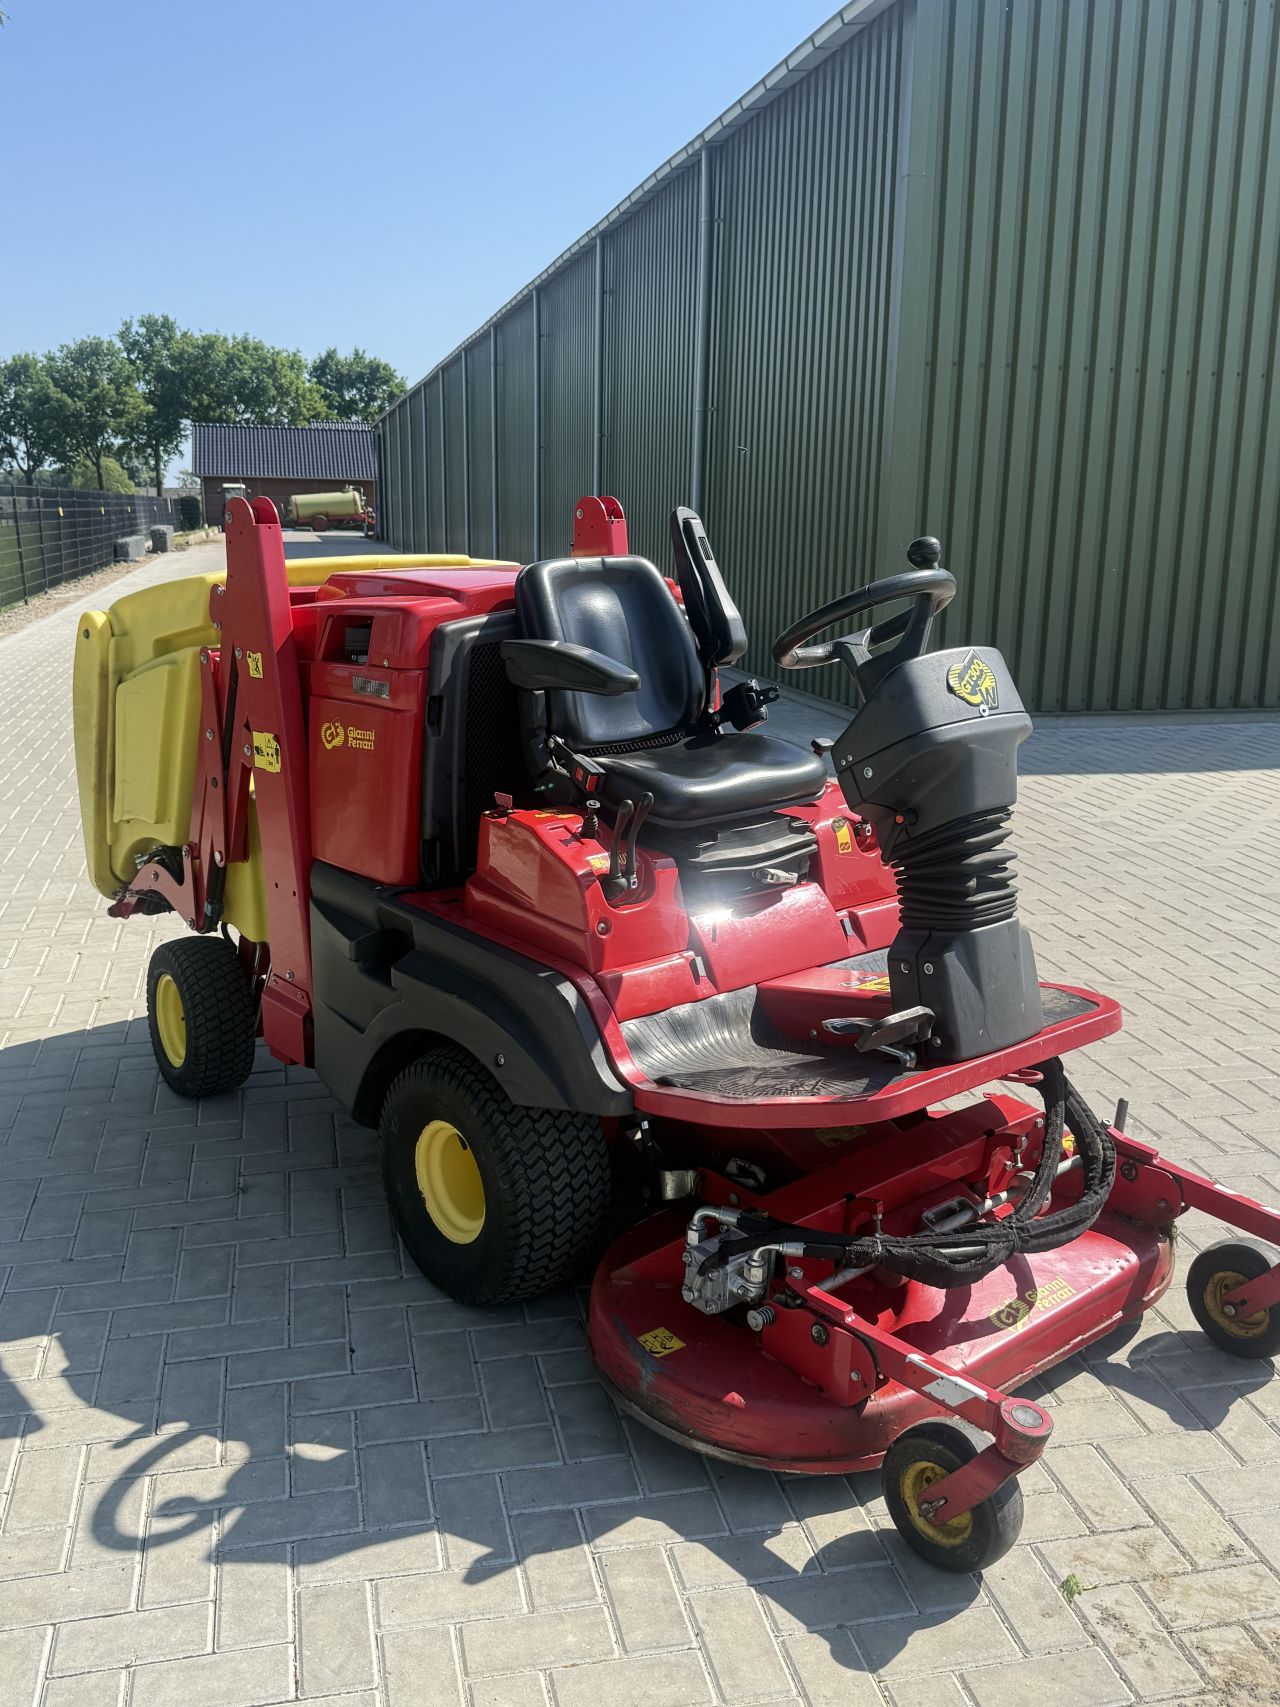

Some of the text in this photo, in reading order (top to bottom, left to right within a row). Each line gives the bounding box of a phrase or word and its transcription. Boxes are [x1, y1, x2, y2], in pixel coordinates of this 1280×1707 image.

[961, 659, 983, 693] GT300
[347, 726, 375, 740] Gianni
[348, 738, 374, 750] Ferrari
[1025, 1275, 1067, 1302] Gianni
[1035, 1286, 1076, 1312] Ferrari
